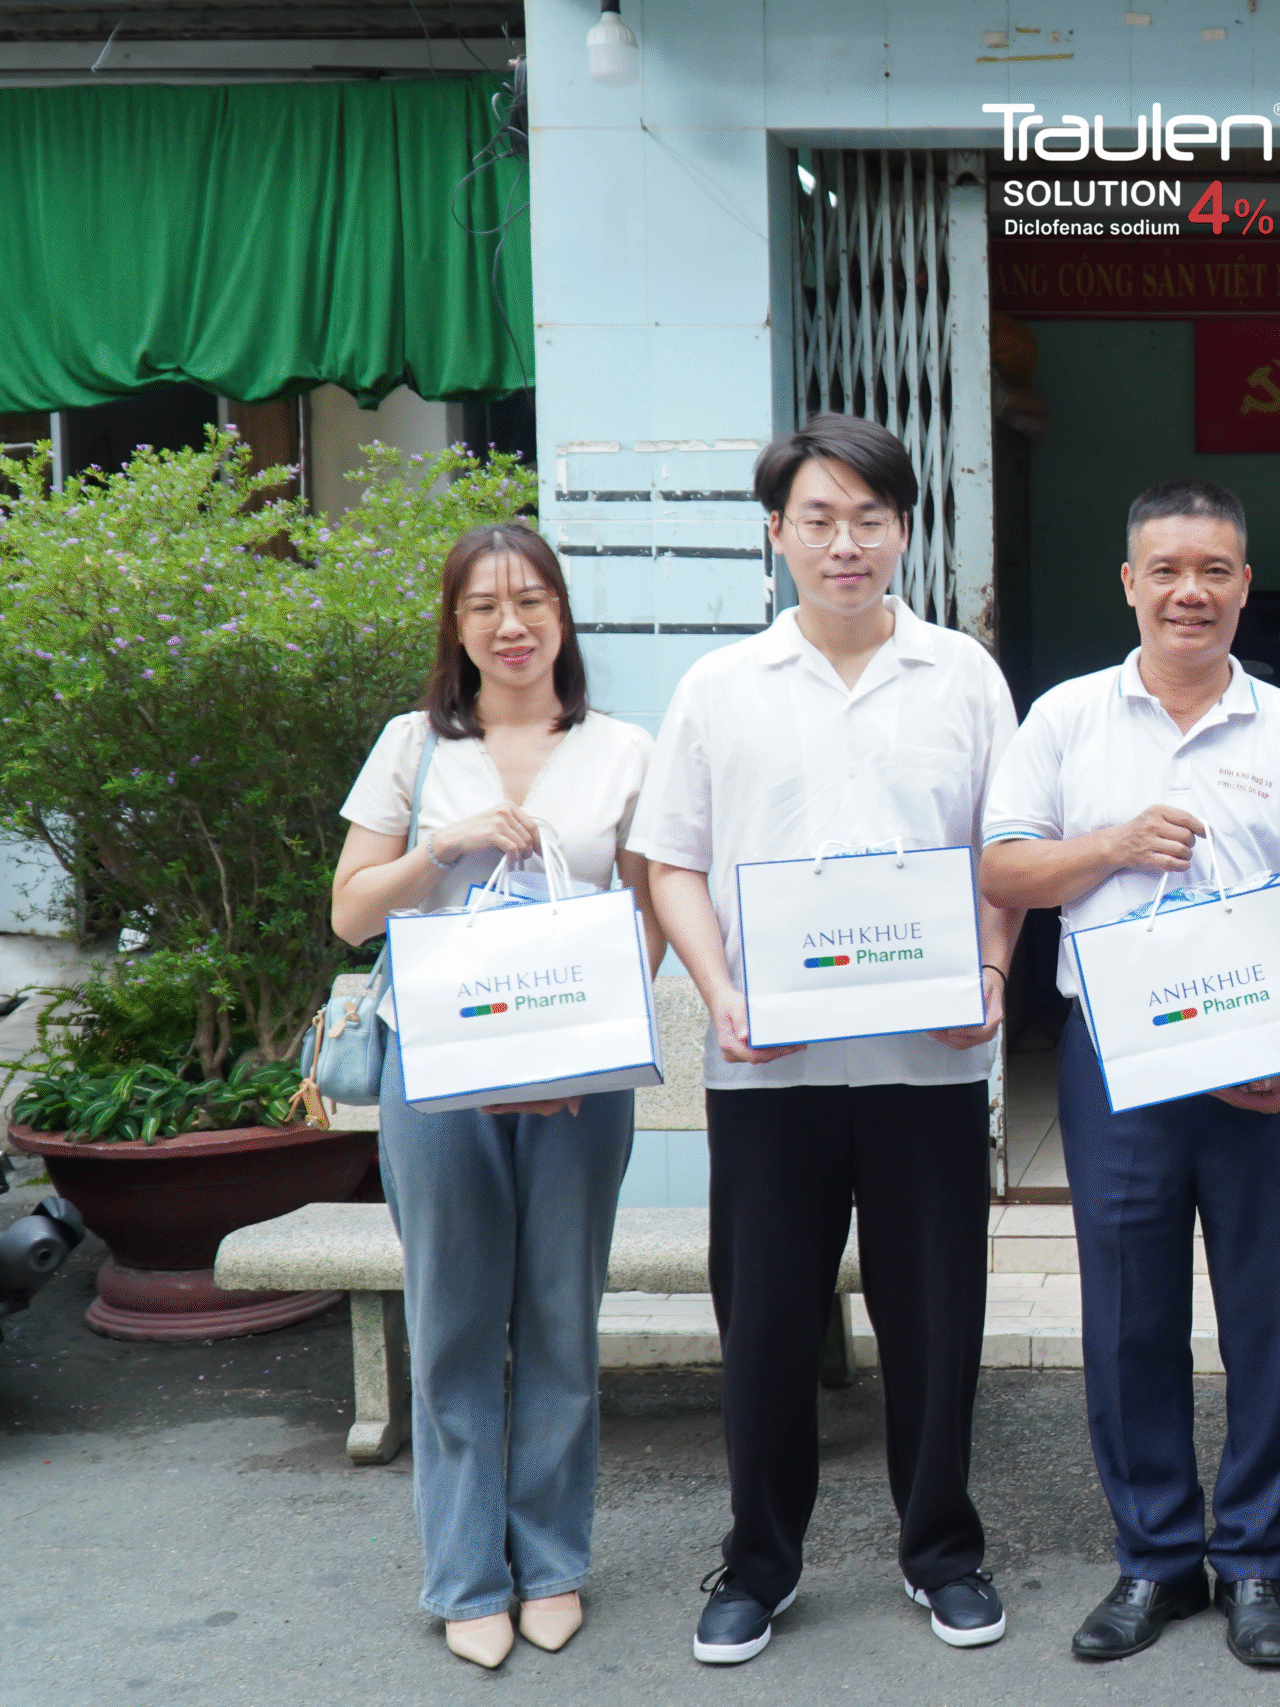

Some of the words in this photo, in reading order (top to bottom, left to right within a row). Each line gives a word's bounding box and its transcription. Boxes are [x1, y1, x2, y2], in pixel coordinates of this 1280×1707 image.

[990, 248, 1049, 298] ẢNG
[1057, 252, 1134, 306] CỘNG
[1142, 247, 1197, 299] SẢN
[1204, 252, 1268, 306] VIỆT
[856, 947, 924, 964] Pharma
[514, 990, 586, 1011] Pharma
[1202, 989, 1271, 1015] Pharma
